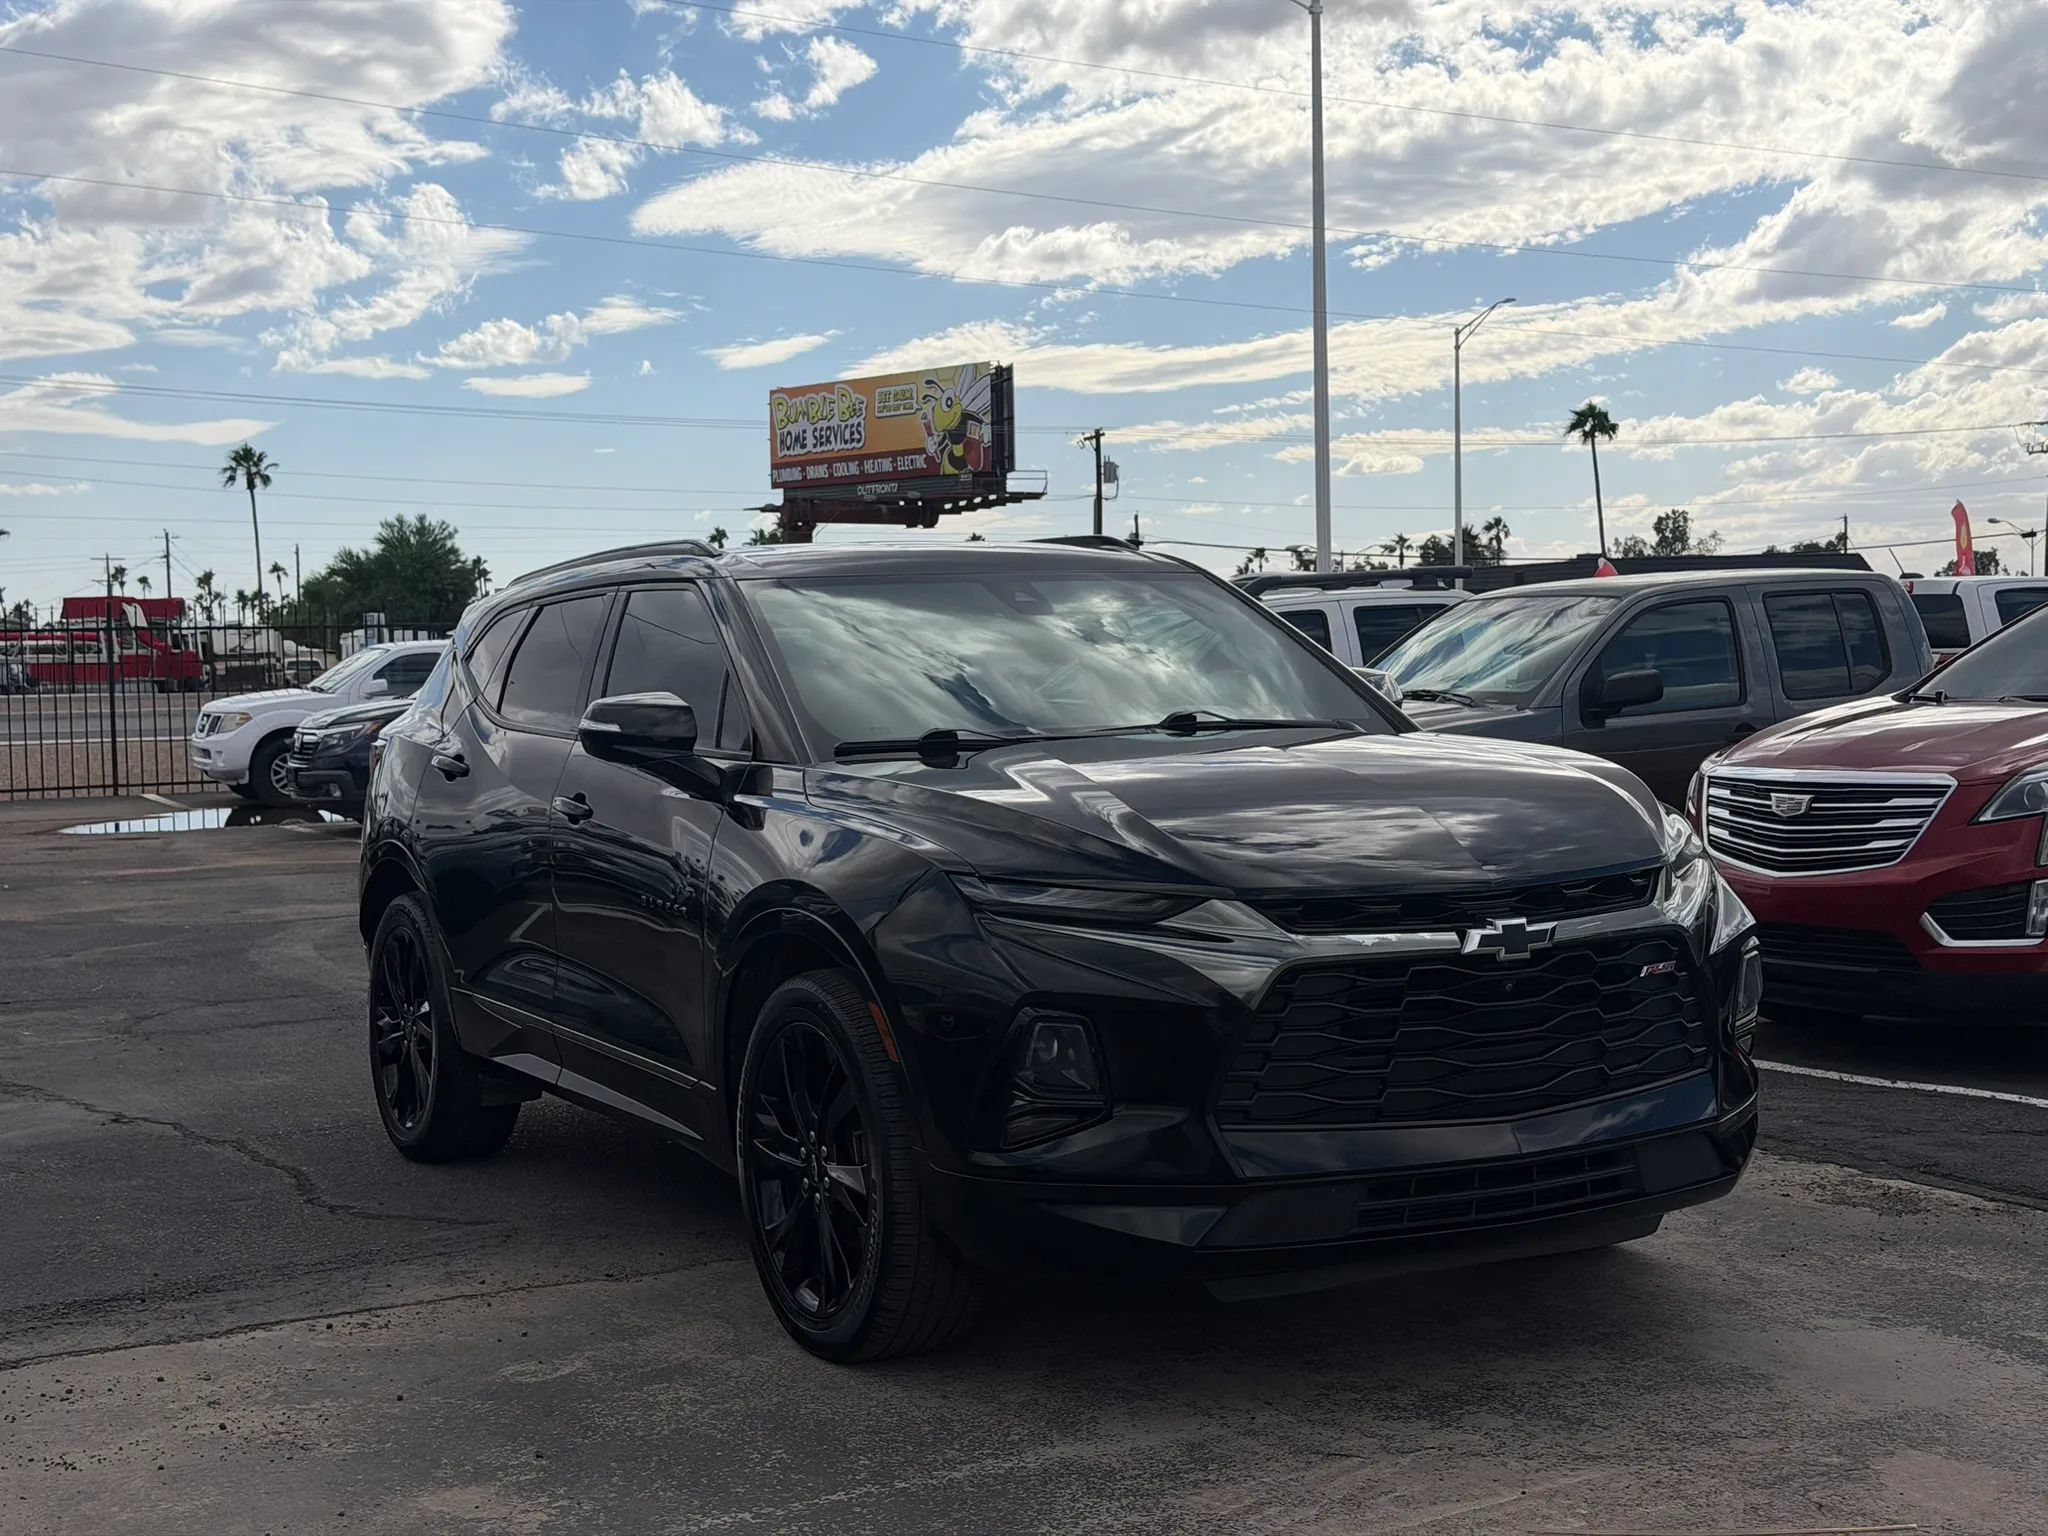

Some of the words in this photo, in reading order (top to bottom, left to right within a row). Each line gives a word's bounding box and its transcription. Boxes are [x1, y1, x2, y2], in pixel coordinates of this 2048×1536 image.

[773, 395, 836, 430] BUMBLE
[836, 387, 865, 422] BEE
[779, 427, 808, 452] HOME
[812, 422, 863, 449] SERVICES
[772, 467, 802, 483] PLUMBING
[806, 463, 829, 480] DRAINS
[833, 461, 860, 477] COOLING
[864, 457, 893, 474] HEATING
[897, 454, 927, 471] ELECTRIC
